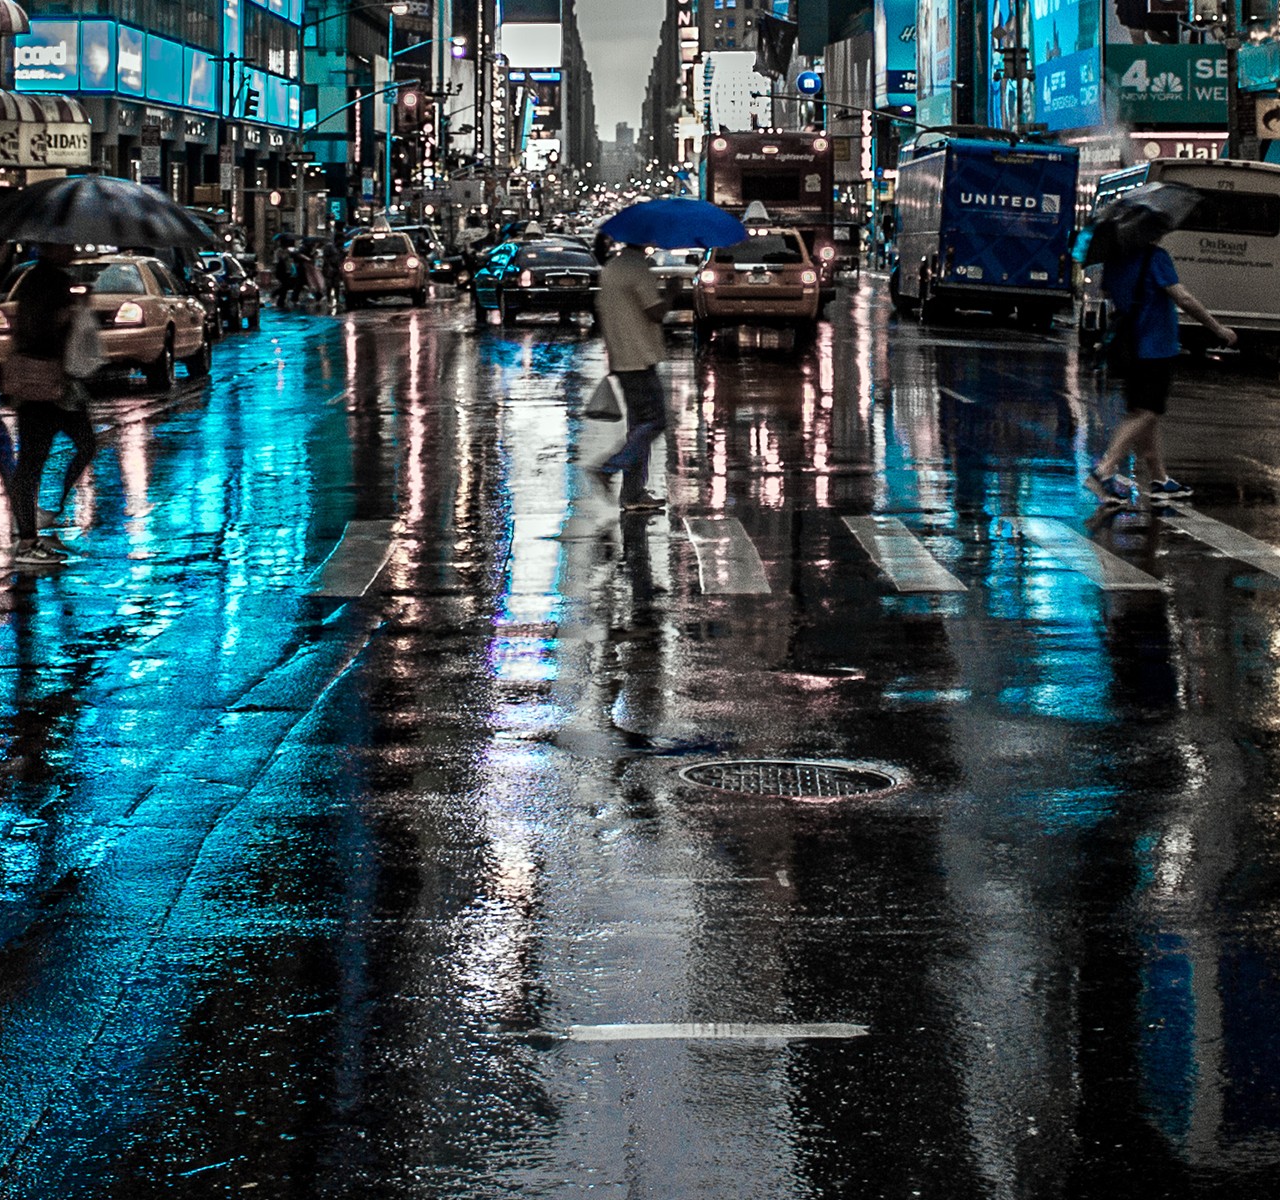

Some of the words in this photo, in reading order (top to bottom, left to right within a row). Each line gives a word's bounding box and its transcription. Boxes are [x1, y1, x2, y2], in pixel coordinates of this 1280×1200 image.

[1120, 59, 1151, 93] 4
[1120, 92, 1148, 101] NEW
[1151, 92, 1183, 101] YORK
[1194, 86, 1229, 101] WE
[960, 191, 1037, 209] UNITED
